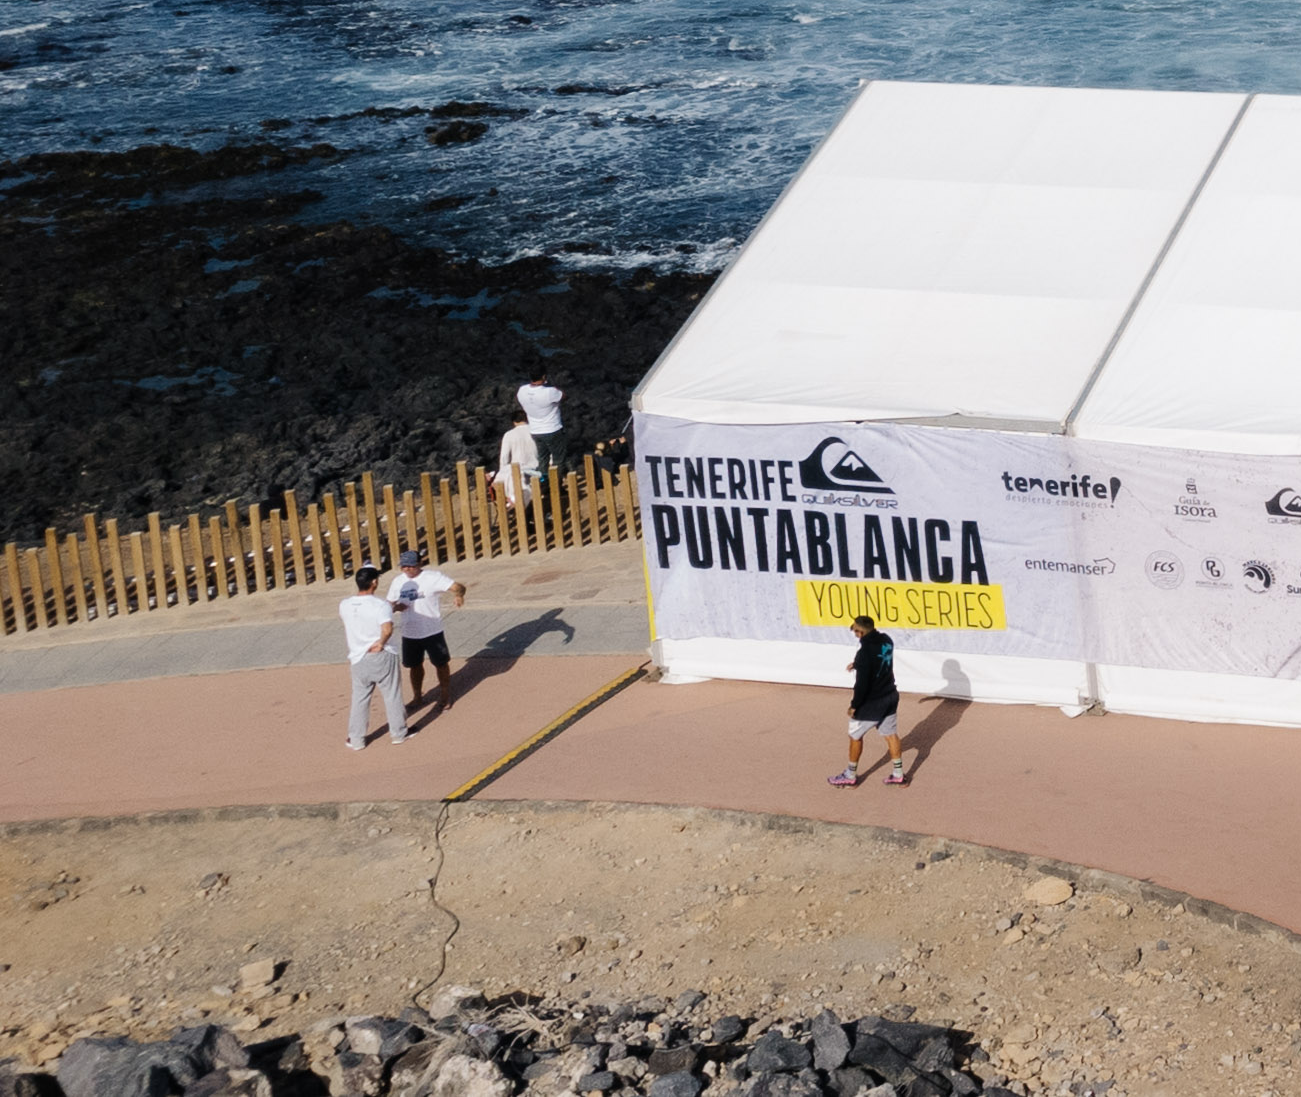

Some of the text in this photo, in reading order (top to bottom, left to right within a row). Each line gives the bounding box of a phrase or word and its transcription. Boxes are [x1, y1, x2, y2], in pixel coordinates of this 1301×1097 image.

[645, 455, 798, 502] TENERIFE
[1002, 471, 1121, 508] tenerife!
[651, 504, 989, 586] PUNTABLANCA
[1025, 558, 1107, 575] entemanser
[1153, 561, 1176, 573] FCS
[810, 582, 994, 629] YOUNG SERIES
